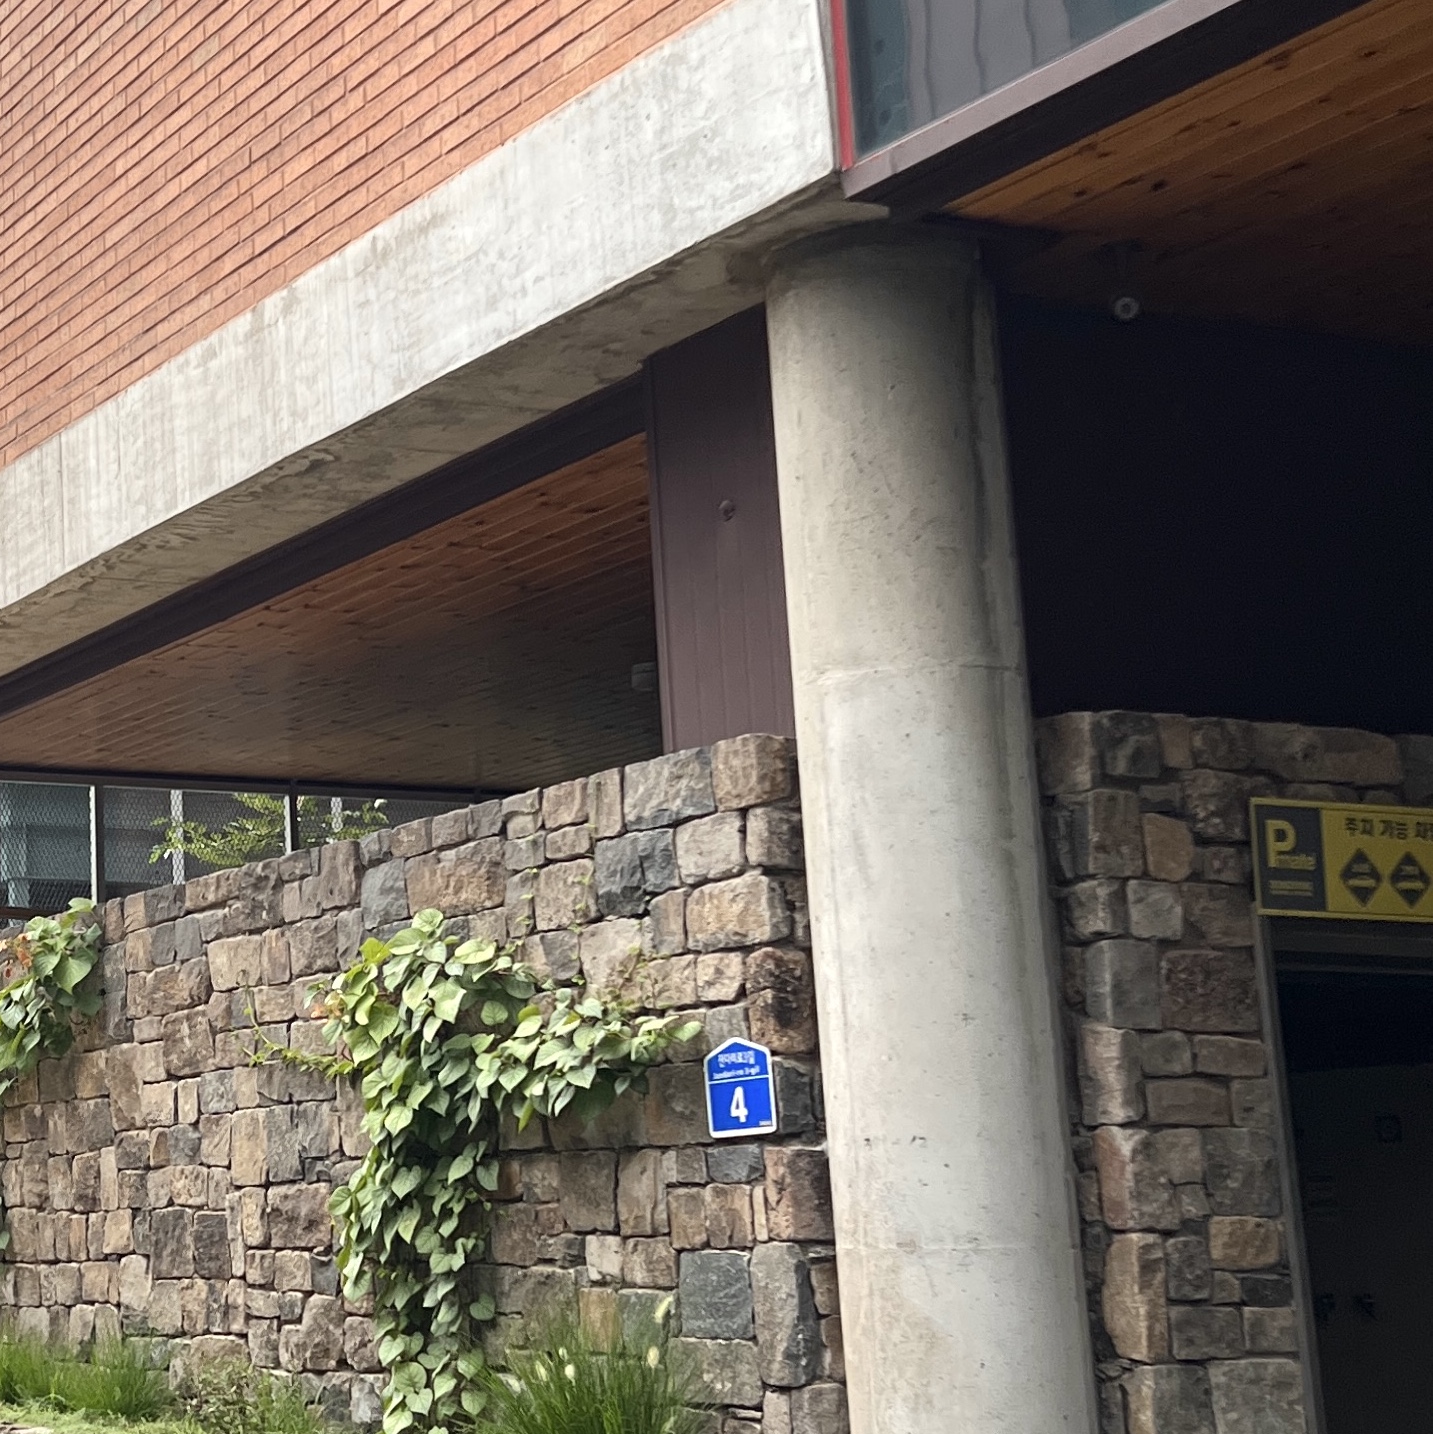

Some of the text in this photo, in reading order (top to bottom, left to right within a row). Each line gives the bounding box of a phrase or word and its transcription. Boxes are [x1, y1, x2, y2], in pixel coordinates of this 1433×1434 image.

[1345, 818, 1375, 837] 주차
[1379, 819, 1407, 840] 가능
[730, 1086, 749, 1123] 4
